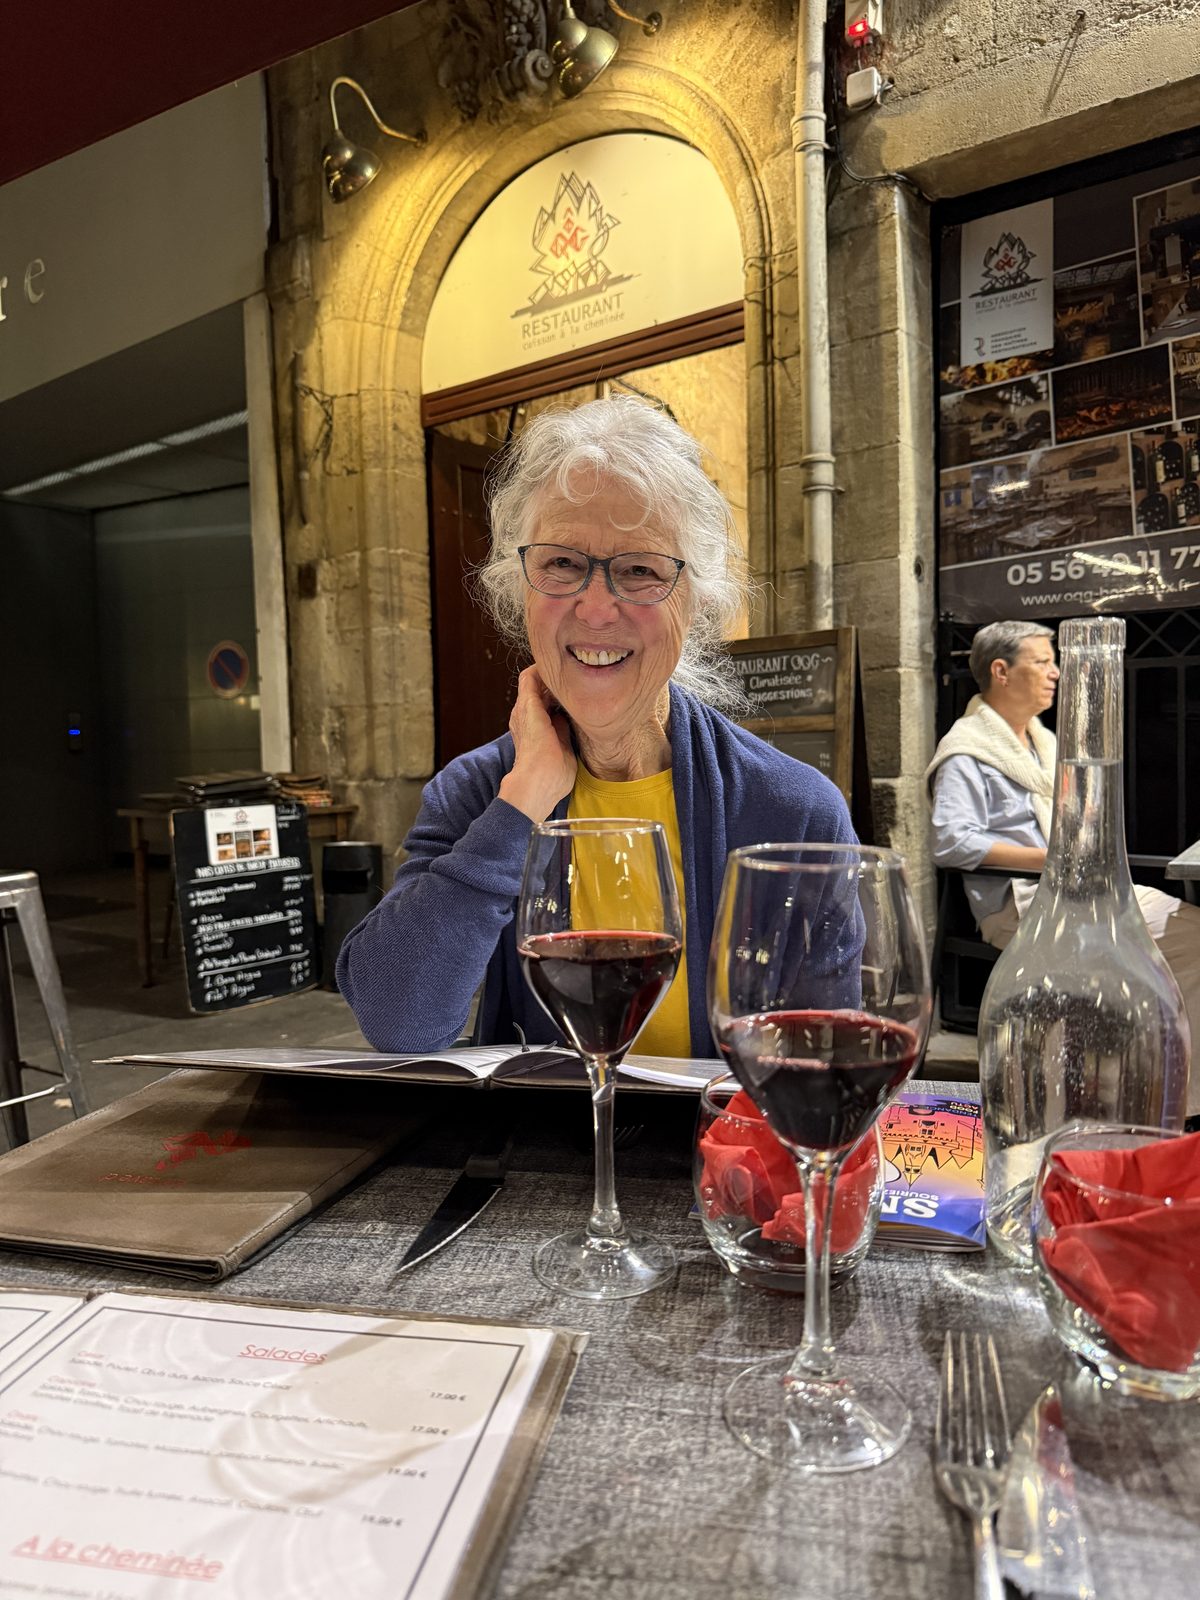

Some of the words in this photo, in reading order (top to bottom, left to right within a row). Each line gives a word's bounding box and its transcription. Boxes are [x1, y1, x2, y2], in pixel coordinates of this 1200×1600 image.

[975, 288, 1038, 309] RESTAURANT
[521, 292, 625, 340] RESTAURANT
[571, 324, 581, 335] la
[1007, 562, 1048, 587] 05
[1049, 556, 1086, 582] 56
[1137, 550, 1161, 575] 11
[749, 672, 802, 689] Climatisée
[749, 688, 813, 703] SUGGESTIONS
[949, 1105, 979, 1114] FOOD
[950, 1101, 979, 1110] ACTU
[238, 1344, 328, 1363] Salades
[12, 1535, 42, 1559] A
[46, 1536, 76, 1561] la
[78, 1542, 225, 1580] cheminée
